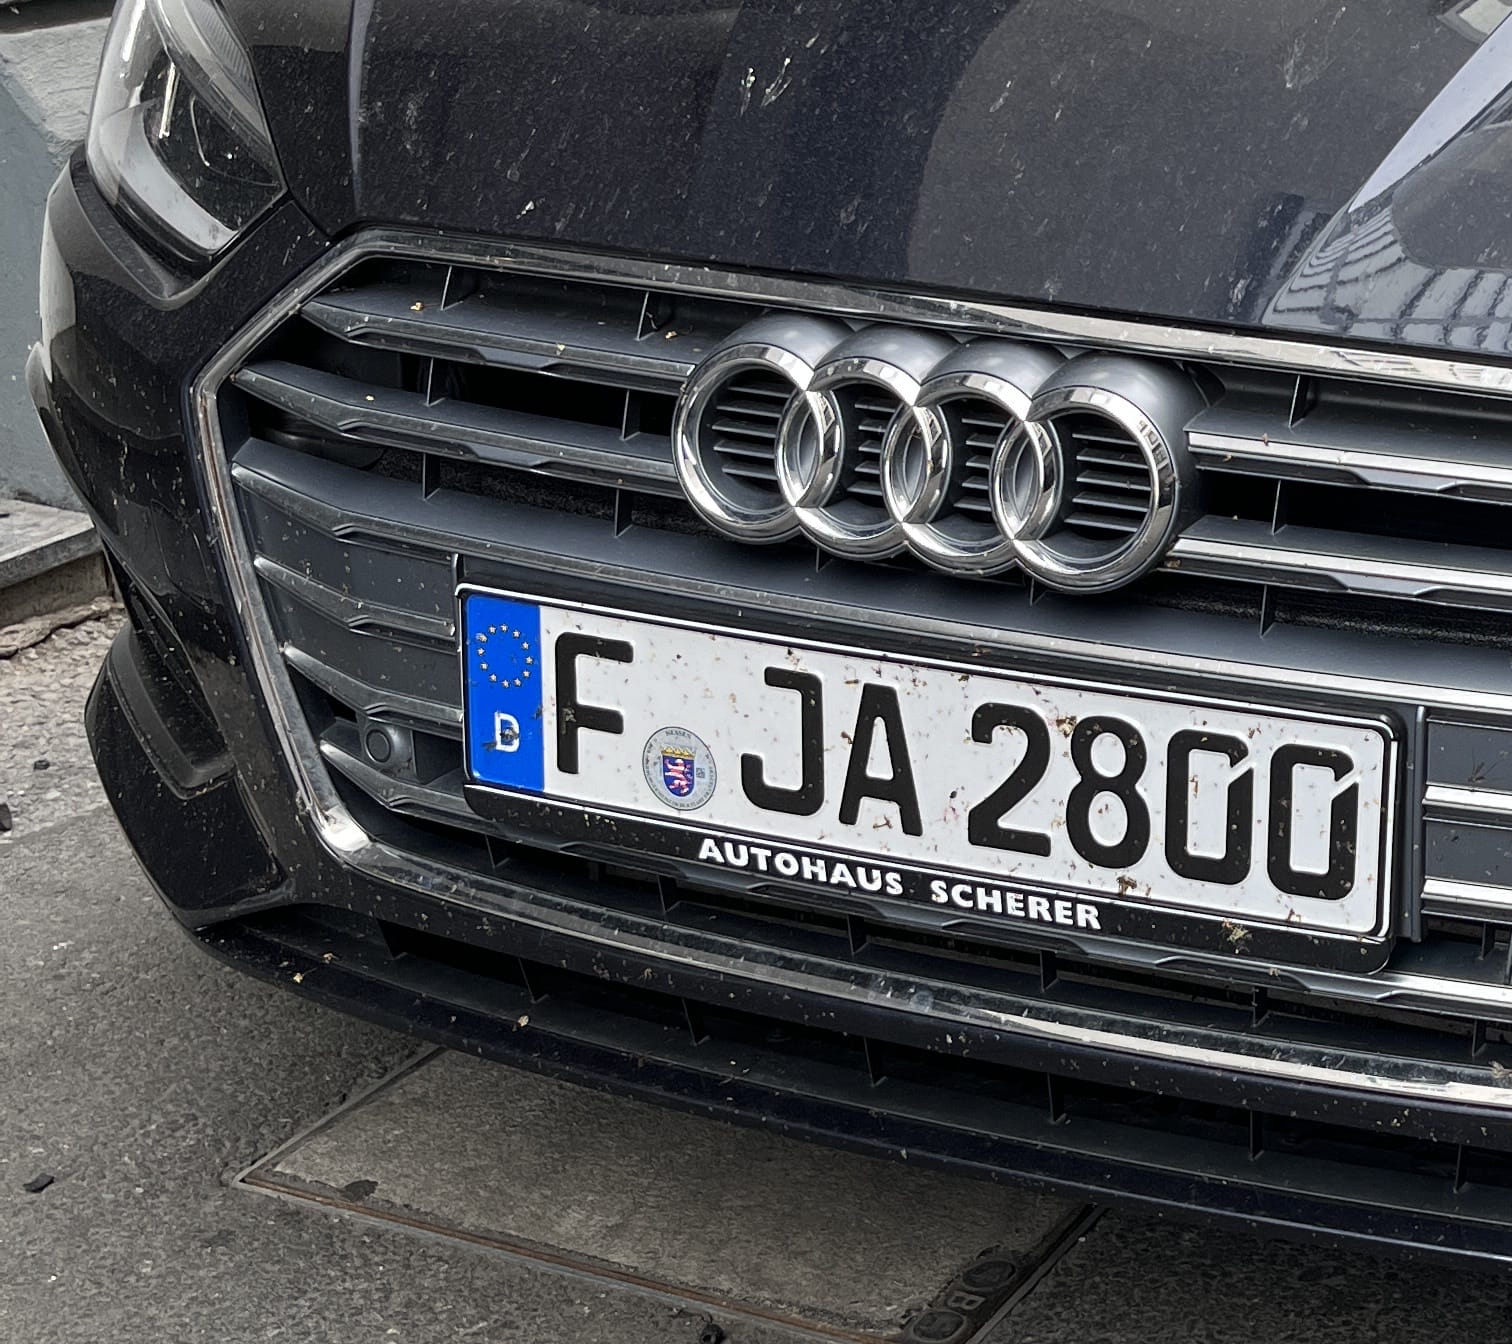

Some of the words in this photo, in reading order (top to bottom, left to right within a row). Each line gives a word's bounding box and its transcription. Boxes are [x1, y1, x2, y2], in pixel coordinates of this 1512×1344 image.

[494, 712, 520, 753] D
[554, 631, 634, 775] F
[739, 666, 923, 837] JA
[967, 702, 1360, 901] 2800
[698, 838, 903, 896] AUTOHAUS
[929, 880, 1102, 930] SCHERER
